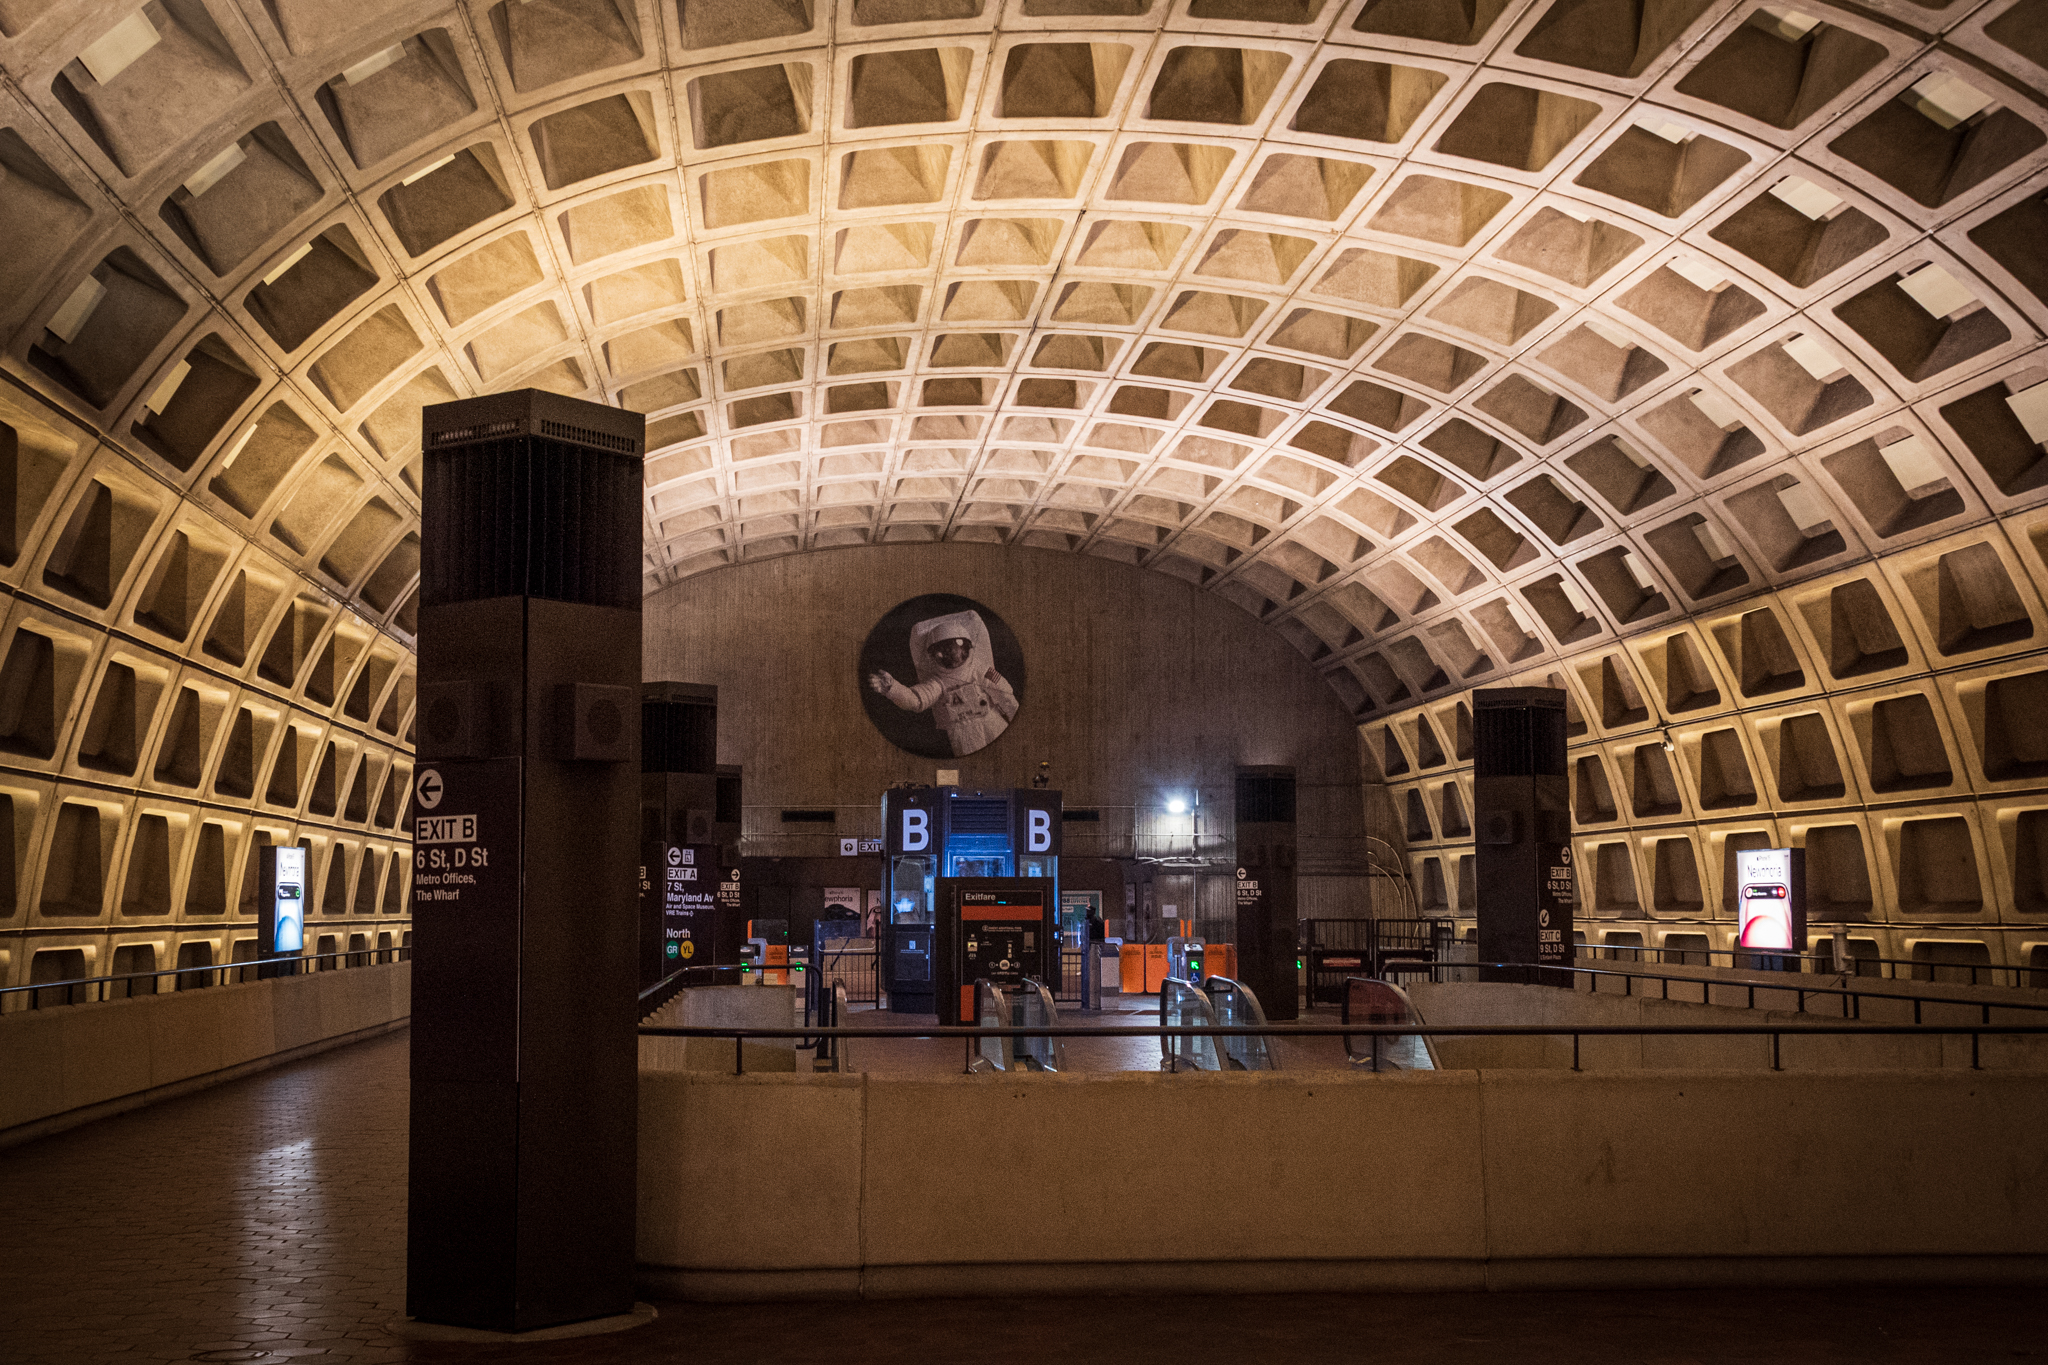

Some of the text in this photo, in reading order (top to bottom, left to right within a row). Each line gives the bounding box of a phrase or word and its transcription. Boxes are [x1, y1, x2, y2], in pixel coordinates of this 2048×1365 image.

[418, 818, 474, 840] EXIT B
[903, 809, 929, 851] B
[1029, 810, 1050, 852] B
[417, 847, 488, 871] 6 St, D St
[669, 869, 696, 879] EXIT A
[1552, 869, 1570, 877] EXIT B
[416, 873, 476, 885] Metro Offices,
[667, 882, 684, 892] 7 St,
[1548, 881, 1551, 889] 6
[1561, 881, 1564, 889] D
[1565, 881, 1571, 890] St
[416, 889, 459, 901] The Wharf
[667, 893, 714, 904] Maryland Av
[825, 895, 853, 903] ewphoria
[666, 928, 690, 938] North
[1541, 932, 1560, 940] EXIT C
[683, 945, 692, 954] YL
[1540, 945, 1544, 953] 9
[1553, 944, 1557, 952] D
[1558, 944, 1564, 953] St
